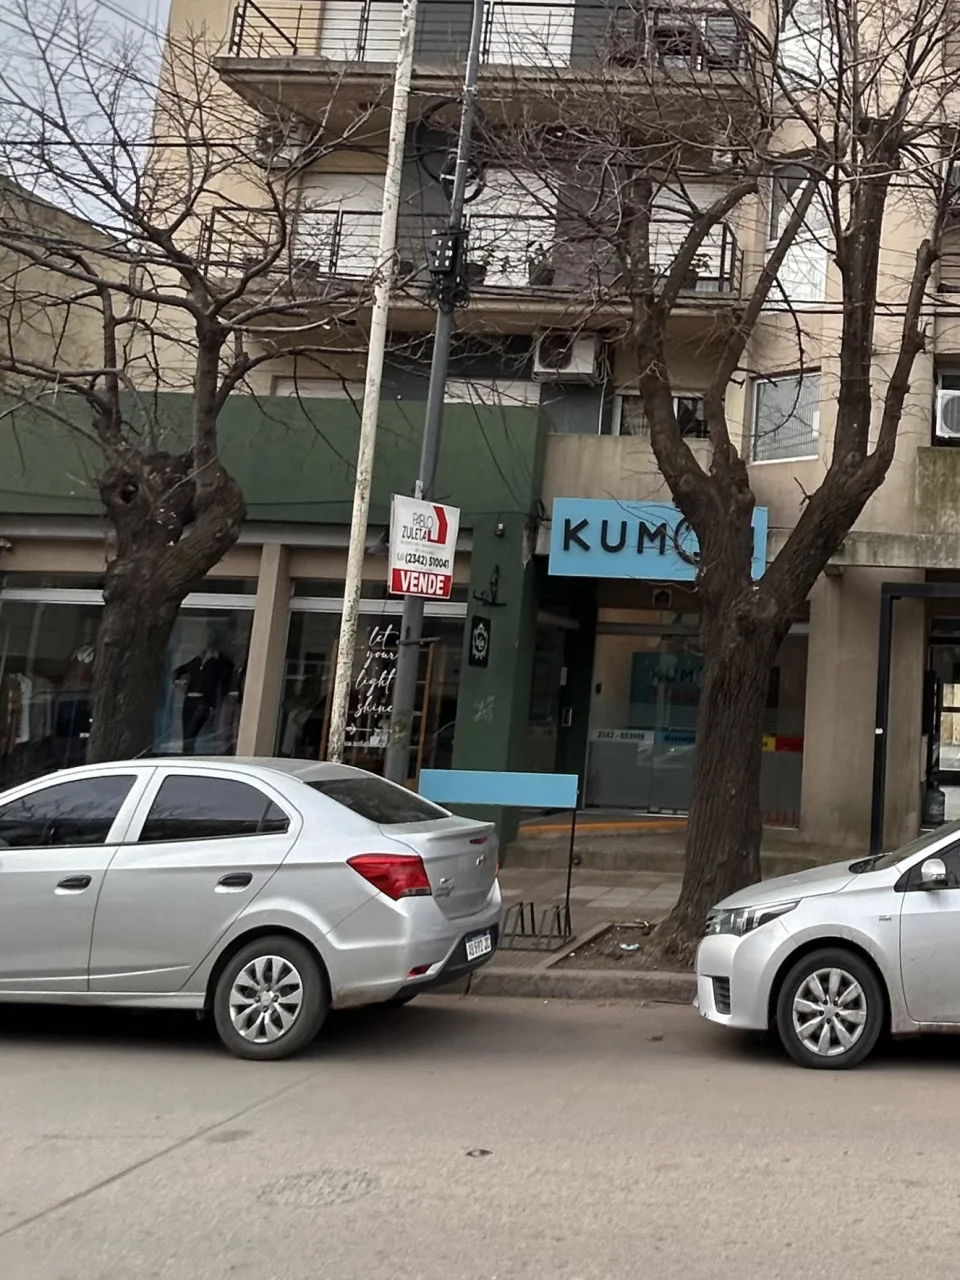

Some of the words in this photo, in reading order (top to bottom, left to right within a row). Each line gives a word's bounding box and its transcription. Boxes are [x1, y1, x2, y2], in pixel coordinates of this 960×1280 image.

[402, 525, 428, 541] ZULETA
[405, 553, 427, 567] (2342)
[401, 570, 444, 595] VENDE
[368, 624, 399, 649] let
[364, 650, 399, 670] your
[355, 668, 396, 696] light
[354, 695, 393, 718] shine
